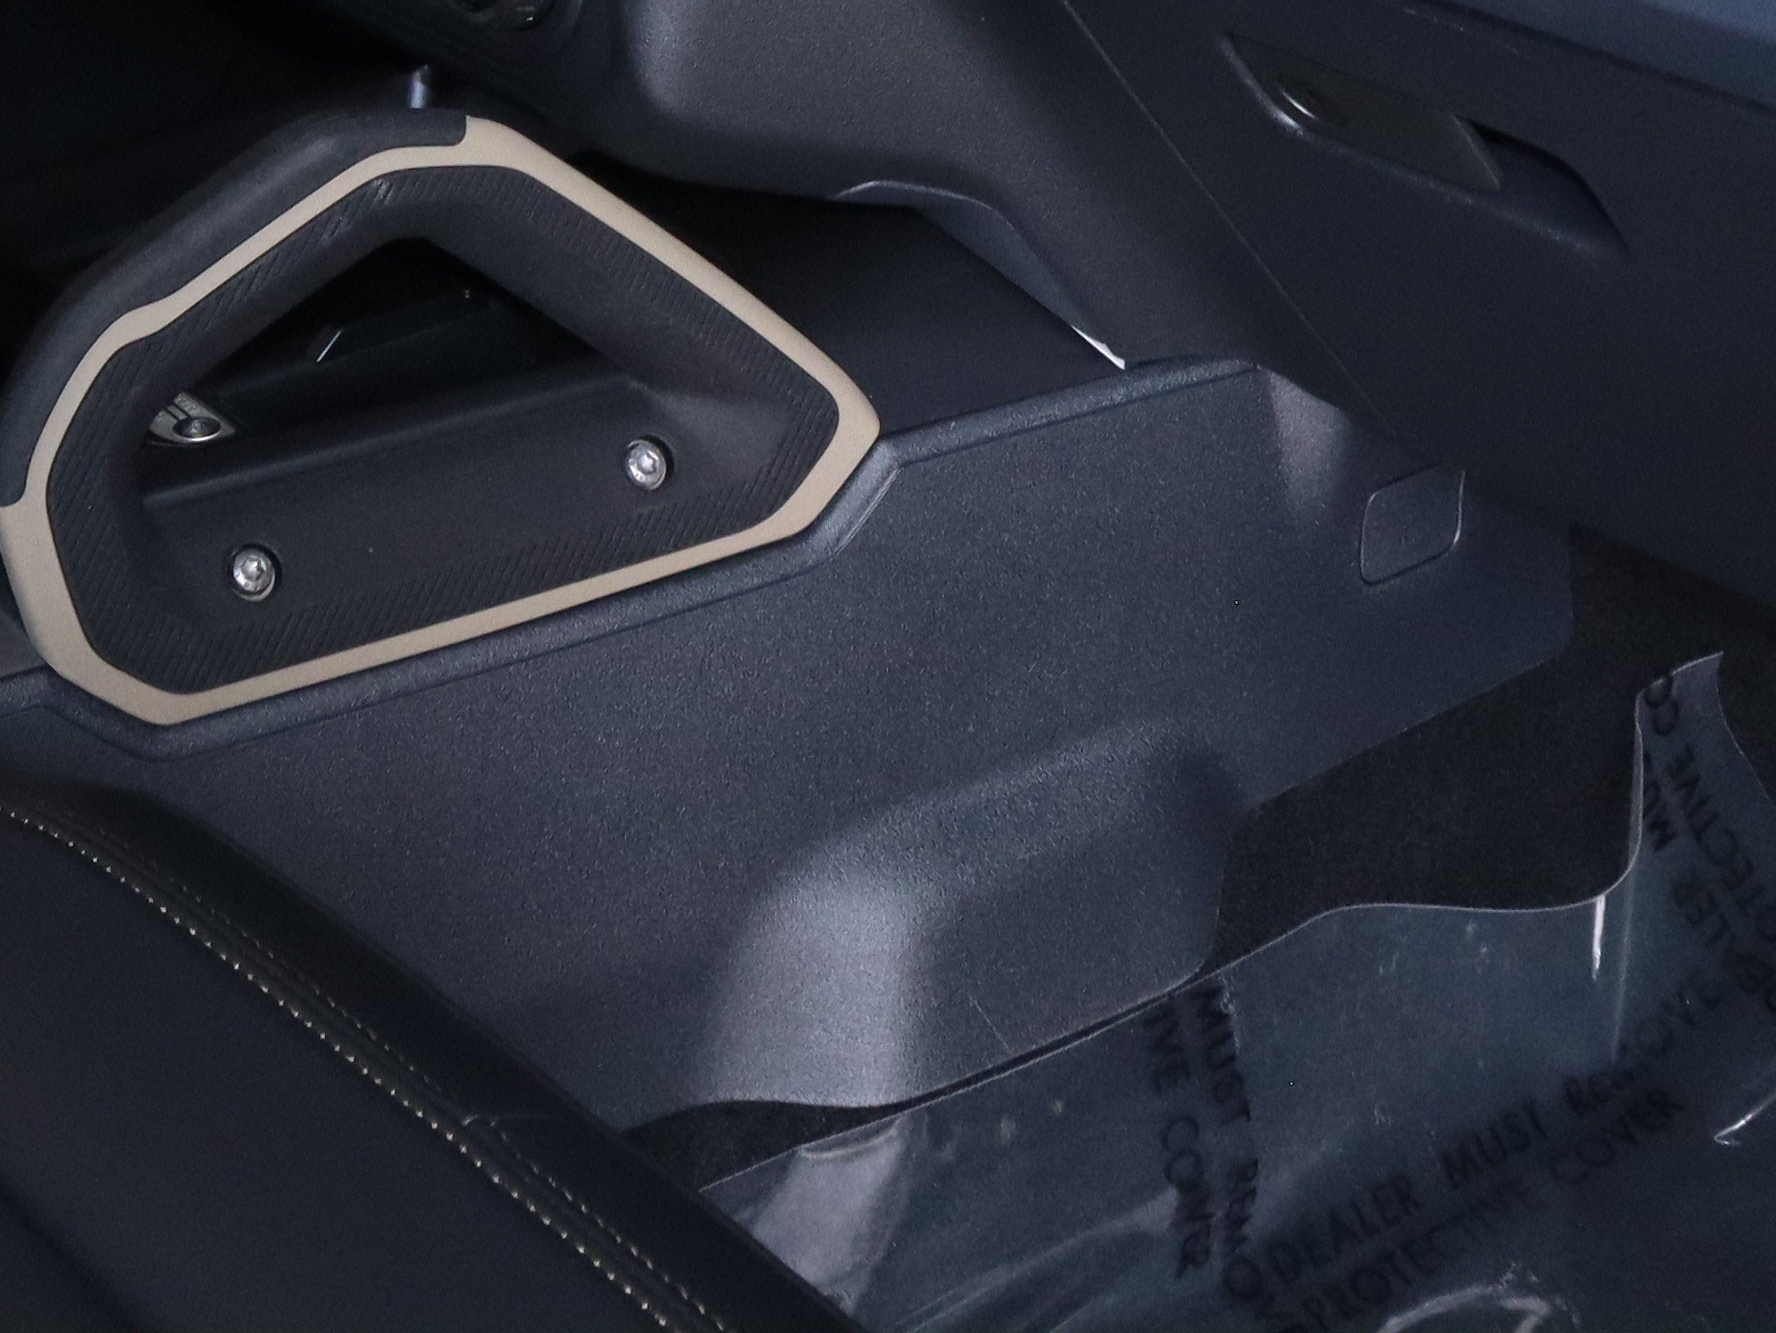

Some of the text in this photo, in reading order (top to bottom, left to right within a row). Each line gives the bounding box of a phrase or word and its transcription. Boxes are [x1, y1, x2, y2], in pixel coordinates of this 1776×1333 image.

[1269, 1171, 1421, 1287] DEALER
[1434, 1098, 1550, 1191] MUST
[1299, 1085, 1684, 1326] PROTECTIVE COVER
